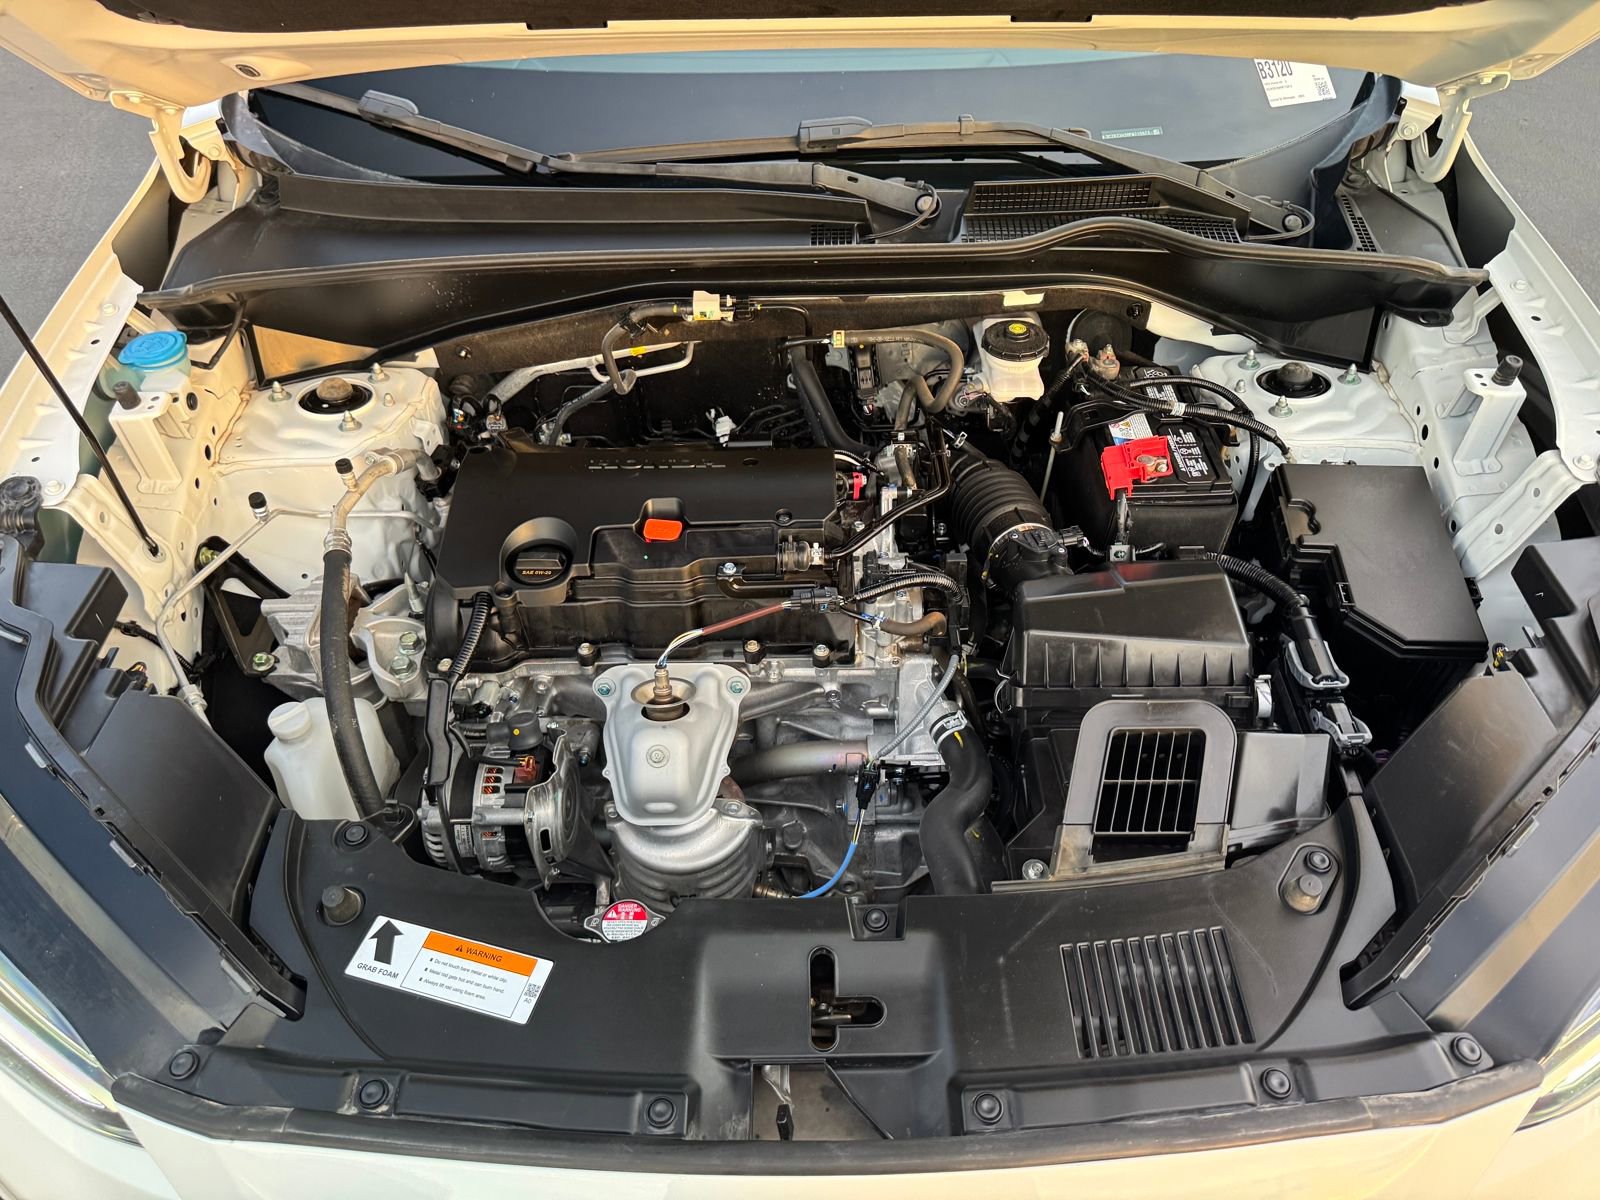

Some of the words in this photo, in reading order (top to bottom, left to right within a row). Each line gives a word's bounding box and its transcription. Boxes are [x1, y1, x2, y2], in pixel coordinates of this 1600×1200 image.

[466, 947, 503, 962] WARNING
[357, 962, 378, 973] GRAB
[378, 968, 400, 979] FOAM
[429, 968, 441, 976] Metal
[448, 962, 460, 970] touch
[471, 969, 482, 977] metal
[423, 978, 438, 987] Always
